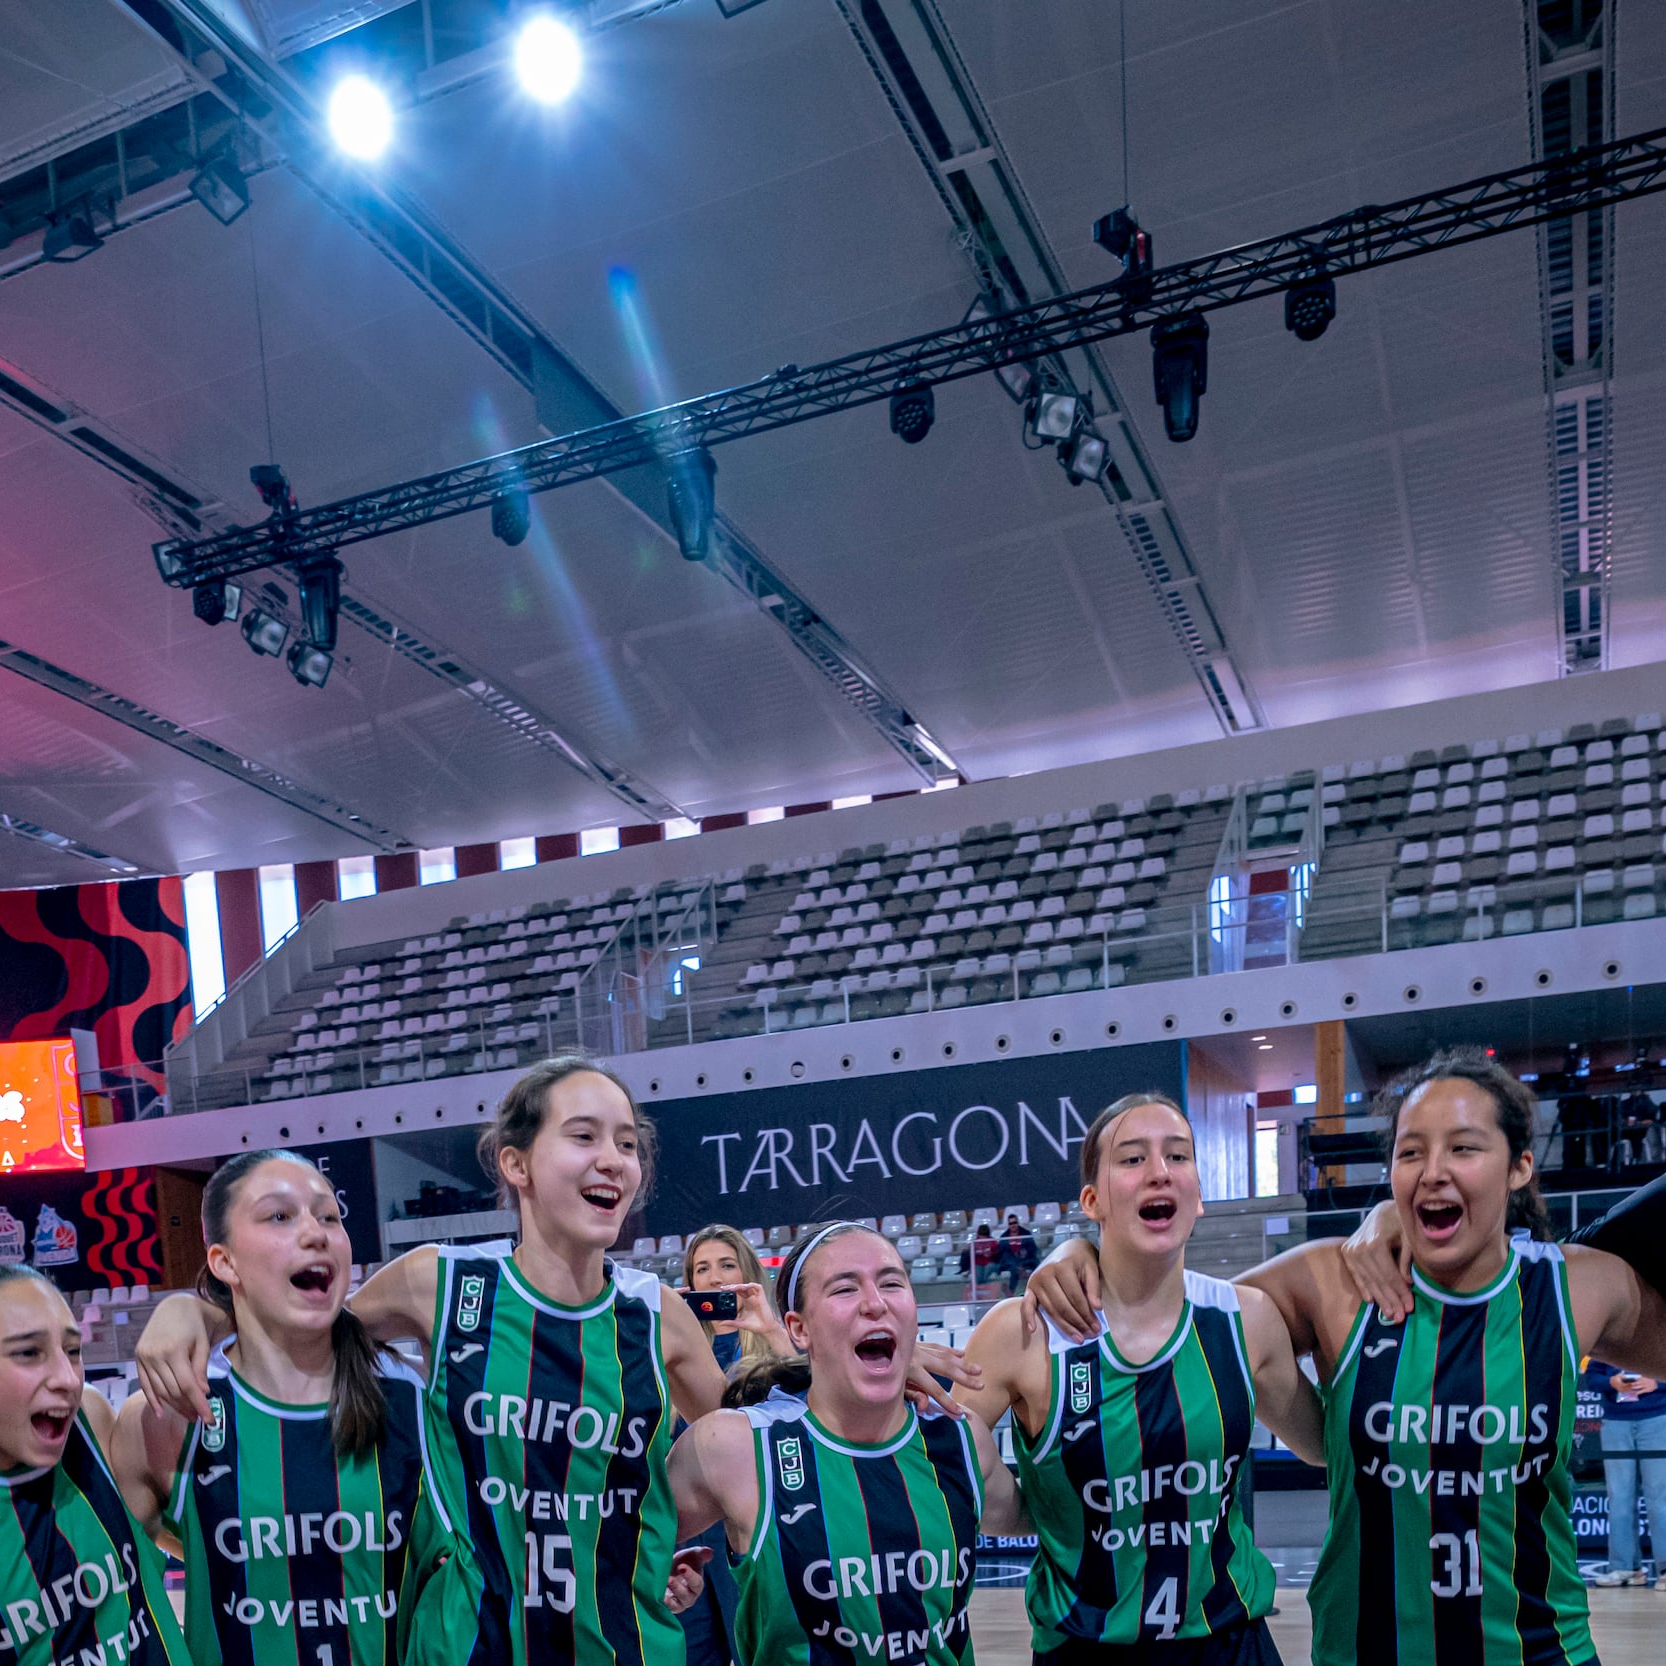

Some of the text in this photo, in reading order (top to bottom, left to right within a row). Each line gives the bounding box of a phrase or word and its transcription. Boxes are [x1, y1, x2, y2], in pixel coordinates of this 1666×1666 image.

[701, 1096, 1089, 1194] TARRAGONA
[463, 1391, 647, 1459] GRIFOLS
[1364, 1401, 1549, 1445] GRIFOLS
[476, 1476, 638, 1521] OVENTUT
[1083, 1454, 1240, 1513] GRIFOLS
[1362, 1452, 1550, 1497] JOVENTUT
[214, 1510, 403, 1563] GRIFOLS
[1429, 1528, 1484, 1599] 31
[524, 1531, 577, 1615] 15
[802, 1547, 972, 1600] GRIFOLS
[223, 1590, 398, 1628] JOVENTU
[812, 1606, 968, 1661] JOVENTUT
[1144, 1576, 1180, 1641] 4
